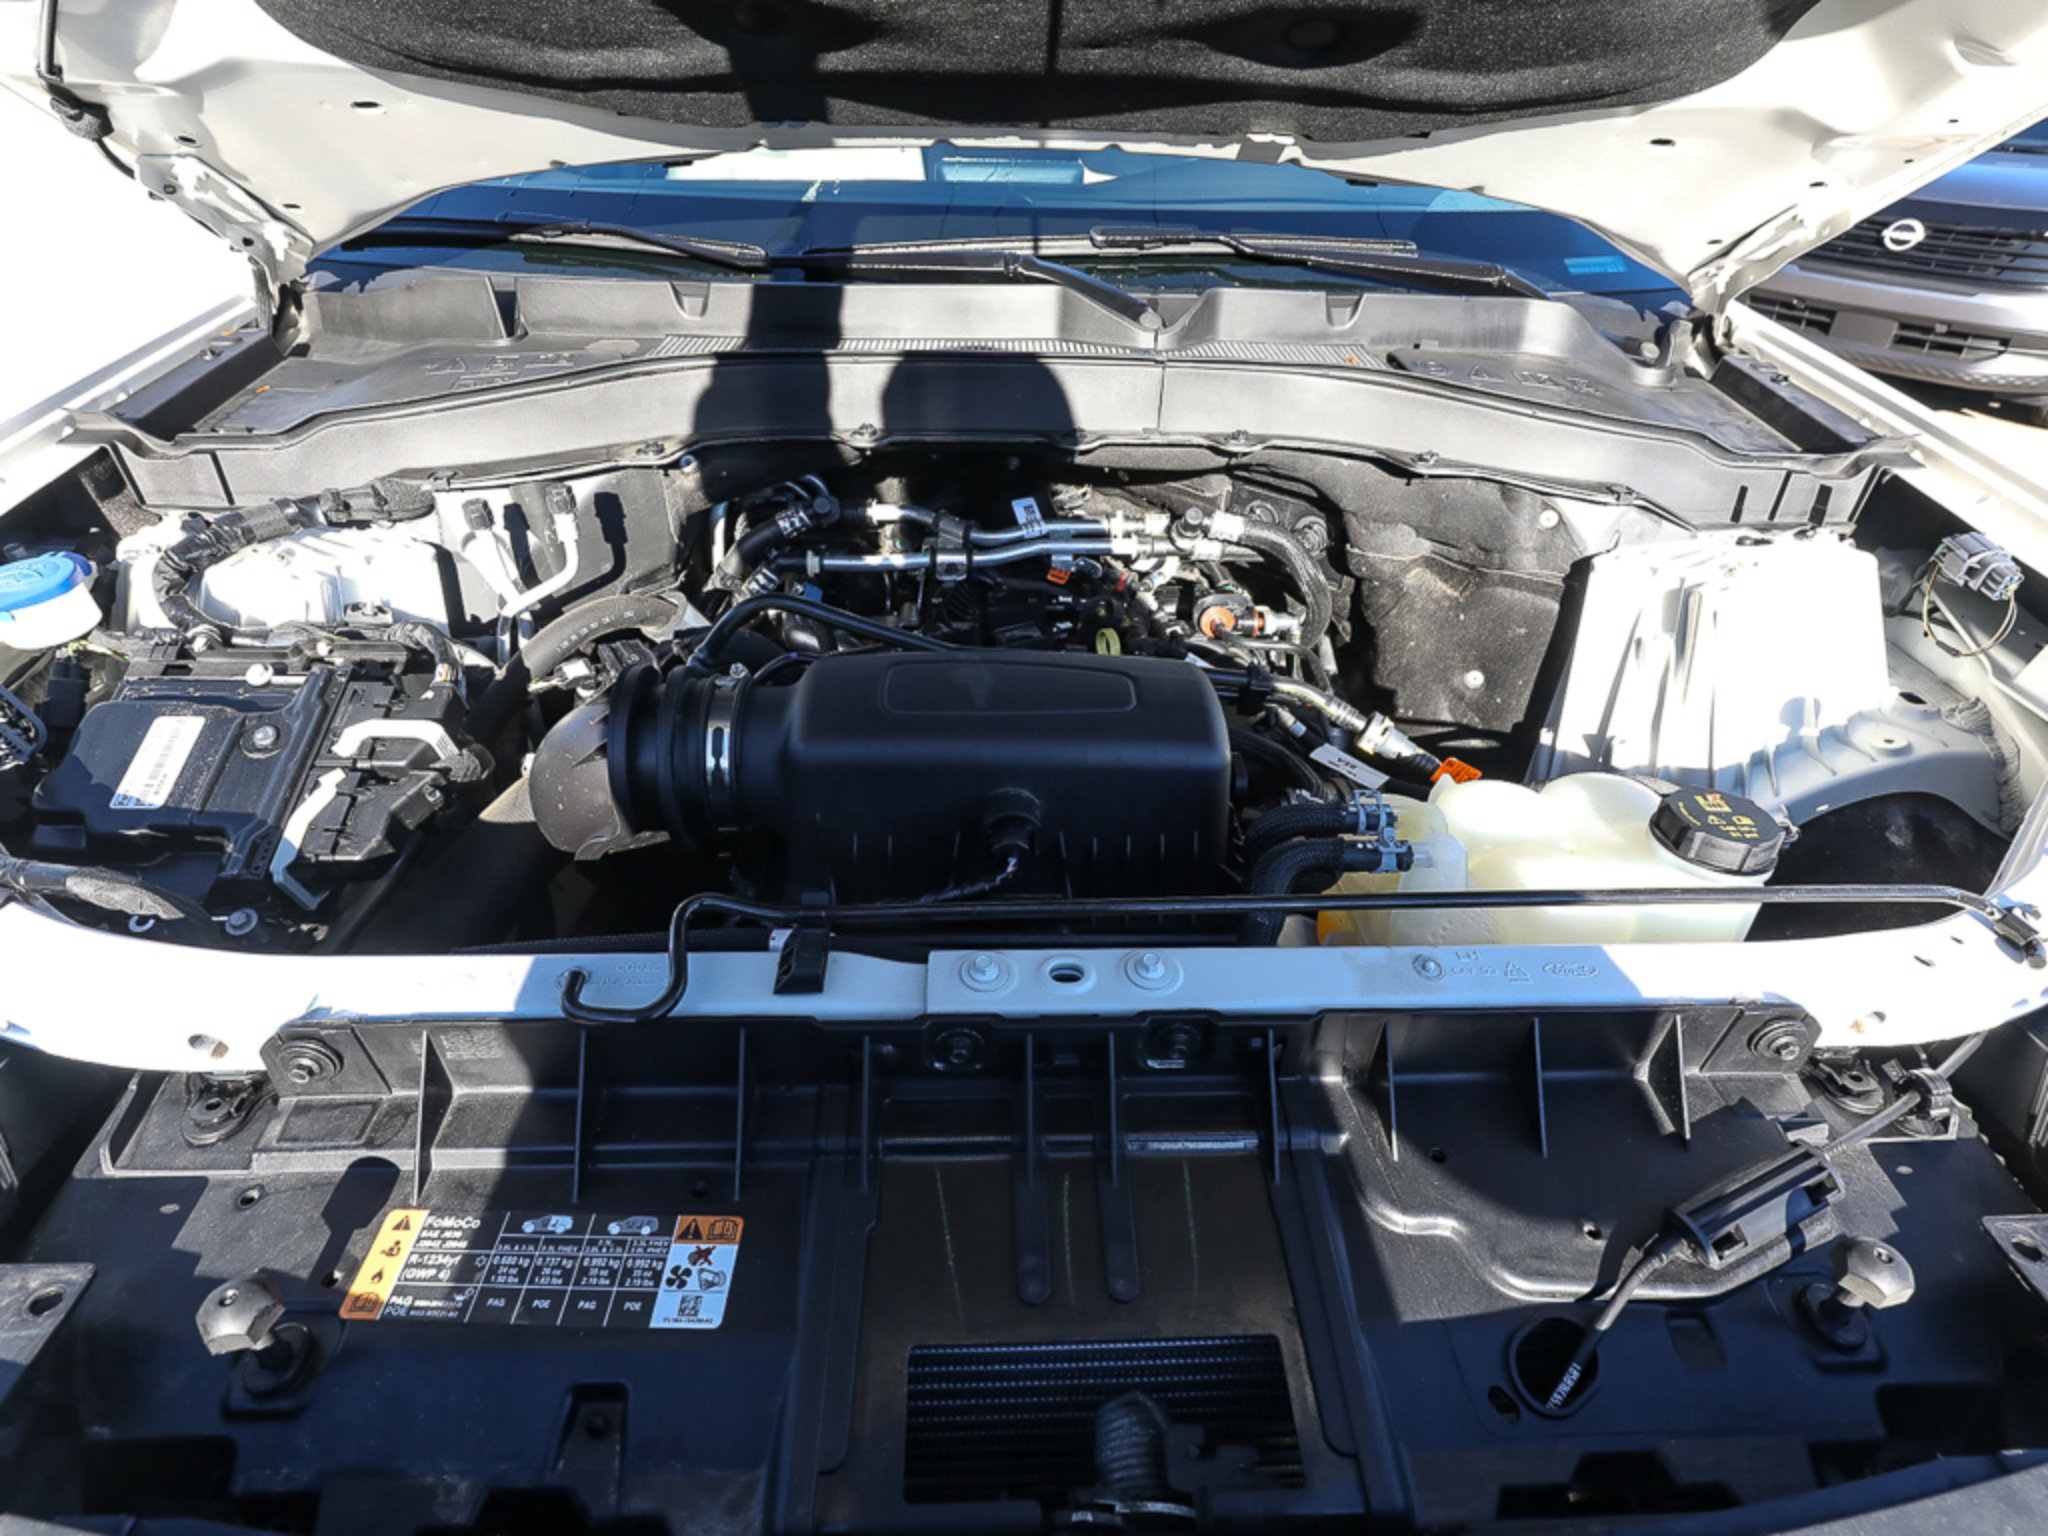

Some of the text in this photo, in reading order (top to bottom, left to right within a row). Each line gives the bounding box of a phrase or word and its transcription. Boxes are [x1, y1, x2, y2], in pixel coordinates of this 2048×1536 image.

[424, 1215, 481, 1229] FoMoCo
[408, 1253, 463, 1267] R-1234yf
[400, 1267, 452, 1282] (GWP 4)
[389, 1295, 413, 1306] PAG
[486, 1297, 507, 1307] PAG
[532, 1299, 552, 1309] POE
[577, 1300, 598, 1310] PAG
[384, 1305, 409, 1317] POE
[623, 1301, 644, 1312] POE
